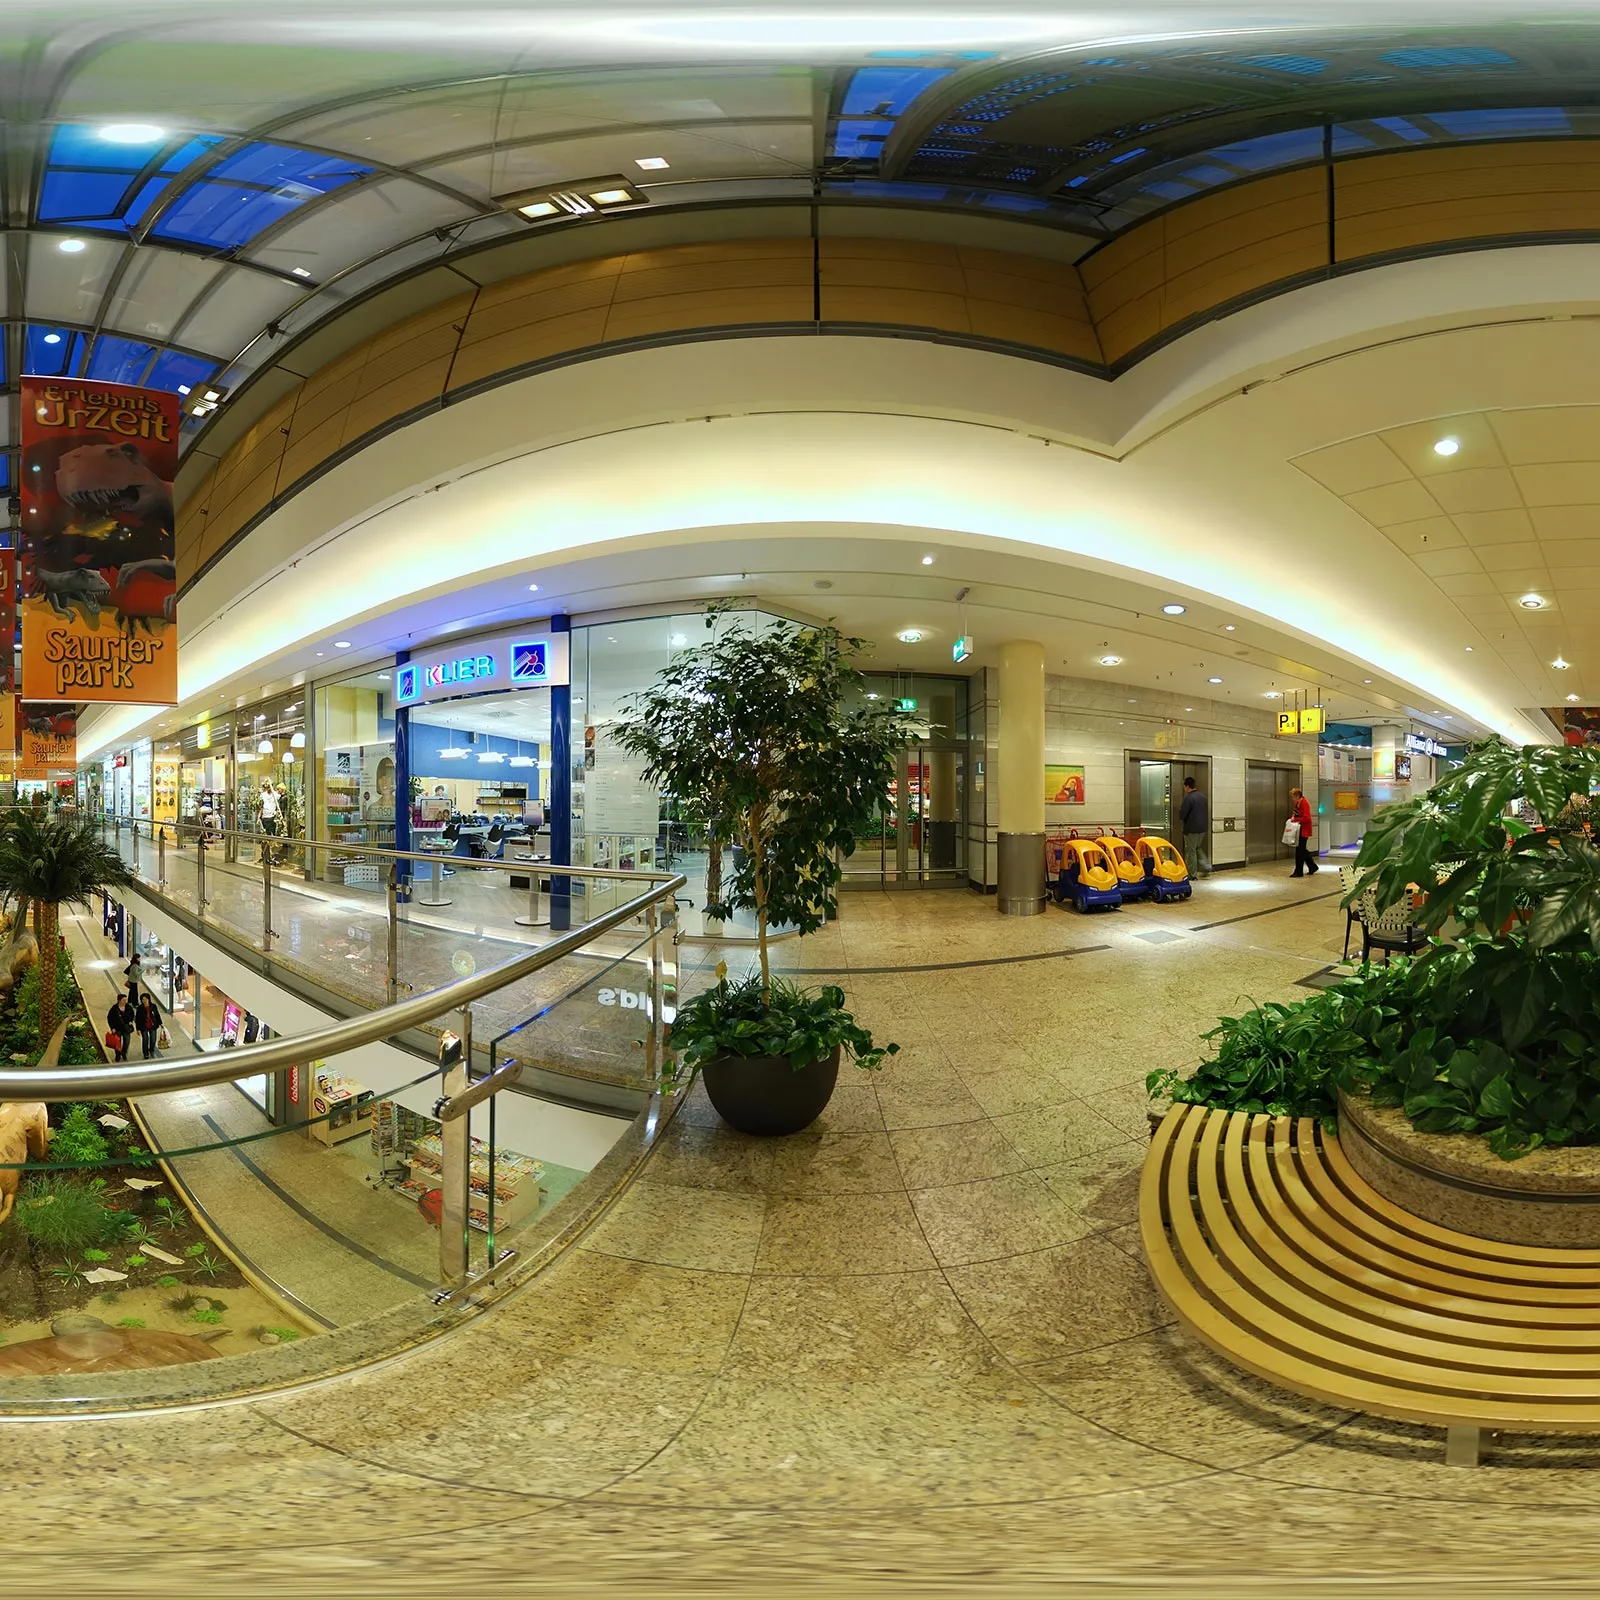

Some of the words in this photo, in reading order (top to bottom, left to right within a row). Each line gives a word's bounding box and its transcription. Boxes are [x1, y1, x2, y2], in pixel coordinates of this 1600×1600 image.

[44, 386, 160, 414] Erlebnis
[35, 399, 171, 443] Urzeit
[44, 628, 163, 664] Saurier
[56, 656, 134, 694] park
[426, 655, 495, 687] KLIER
[1279, 714, 1289, 728] P
[30, 741, 72, 754] Saurier
[1405, 734, 1426, 751] Allianz
[34, 751, 62, 765] park
